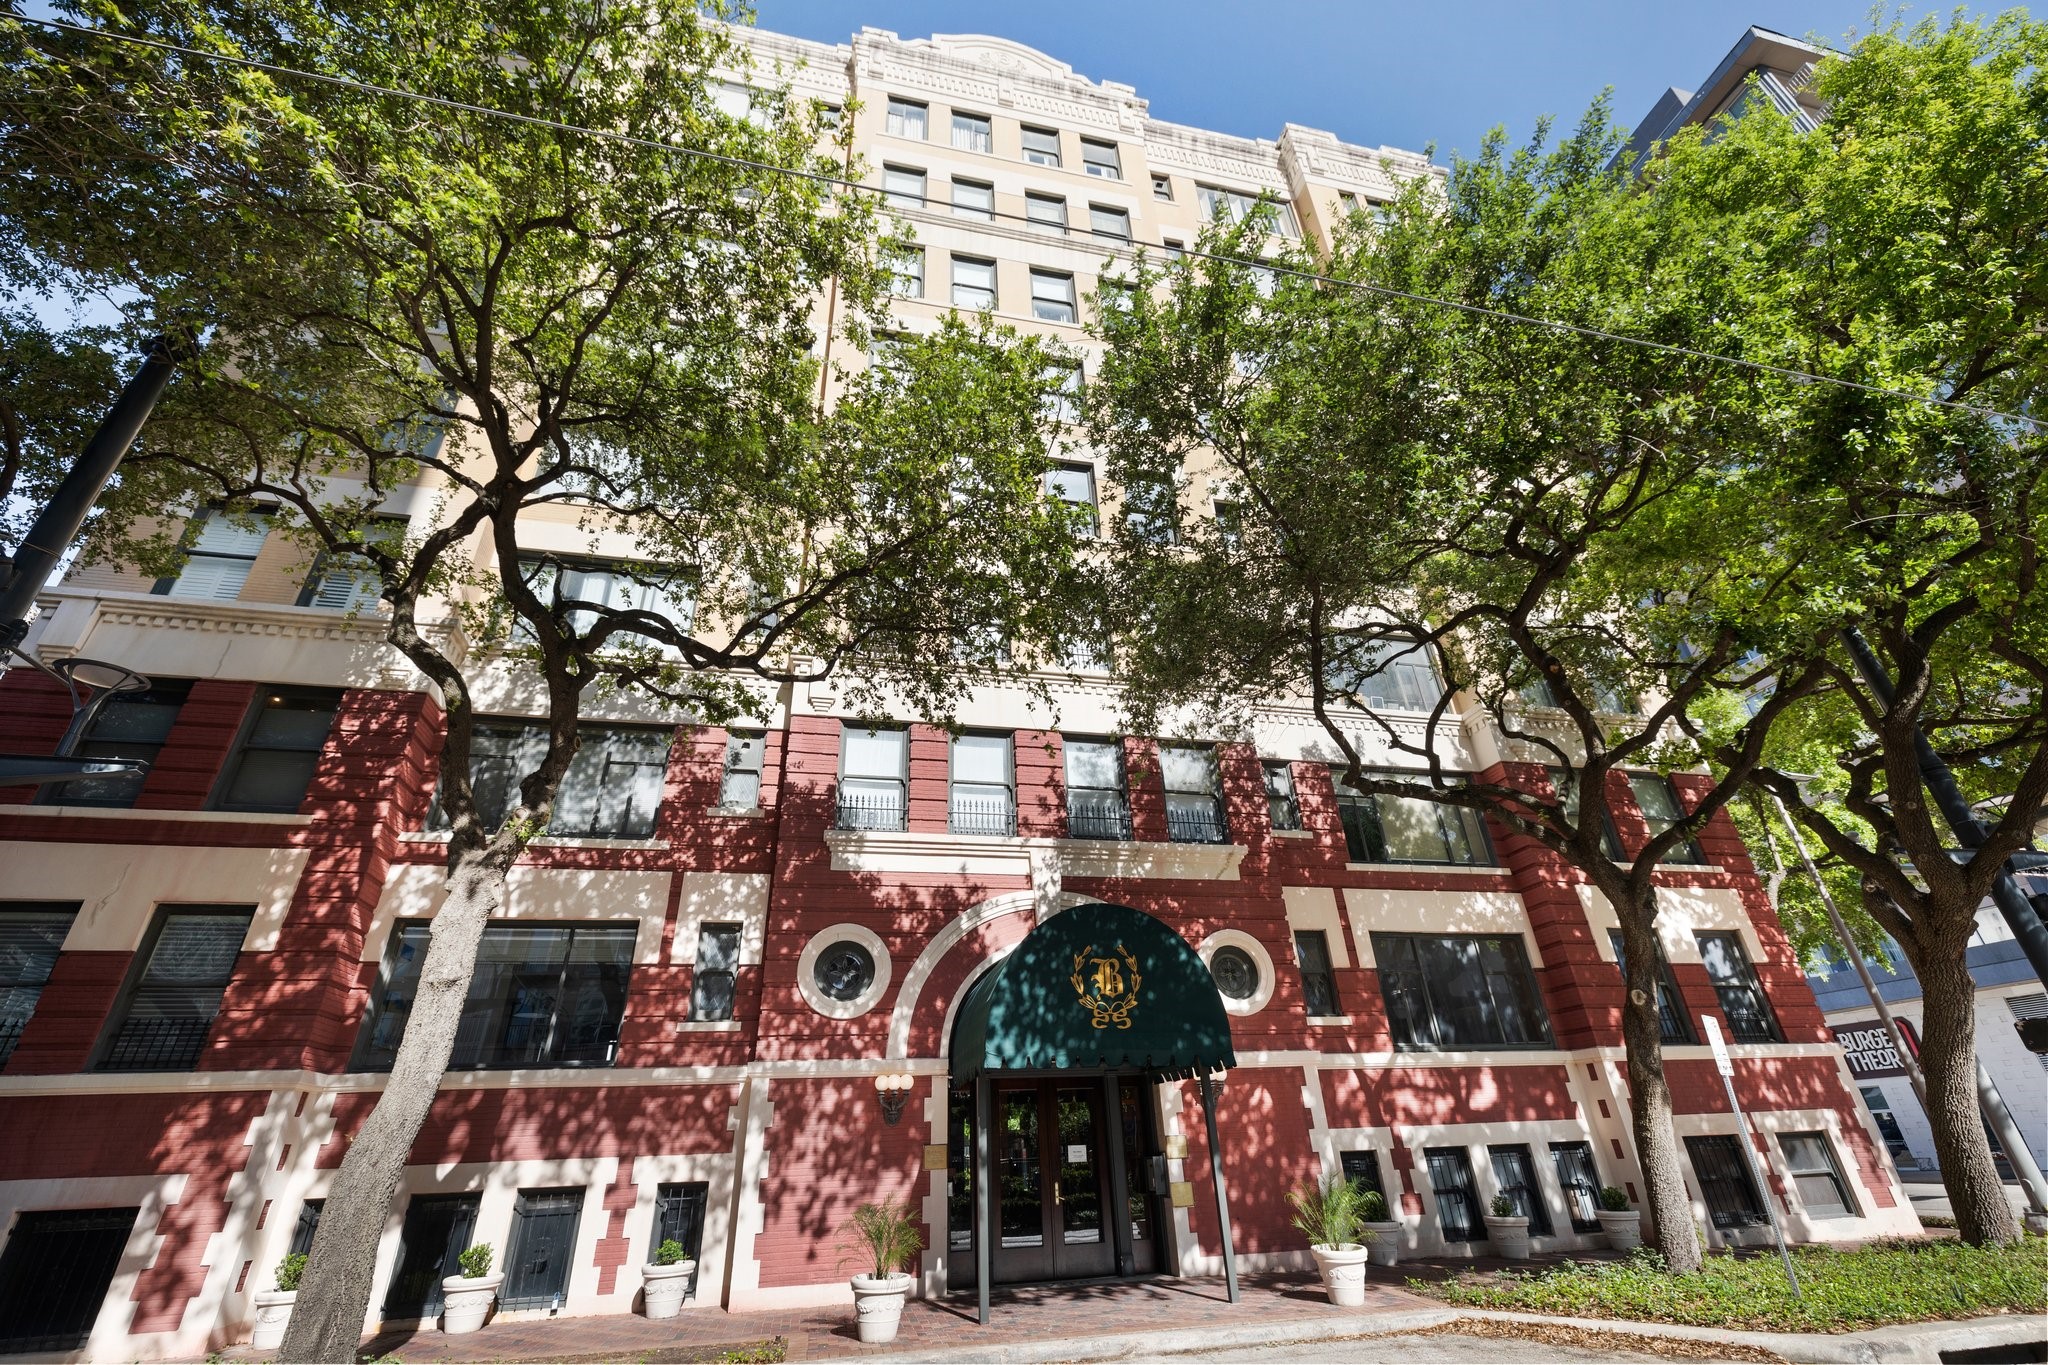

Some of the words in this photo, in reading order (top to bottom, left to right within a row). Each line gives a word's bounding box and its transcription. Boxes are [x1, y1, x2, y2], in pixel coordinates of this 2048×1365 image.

[1090, 958, 1124, 998] B
[1837, 1028, 1894, 1052] BURGE
[1846, 1048, 1904, 1072] THEOR
